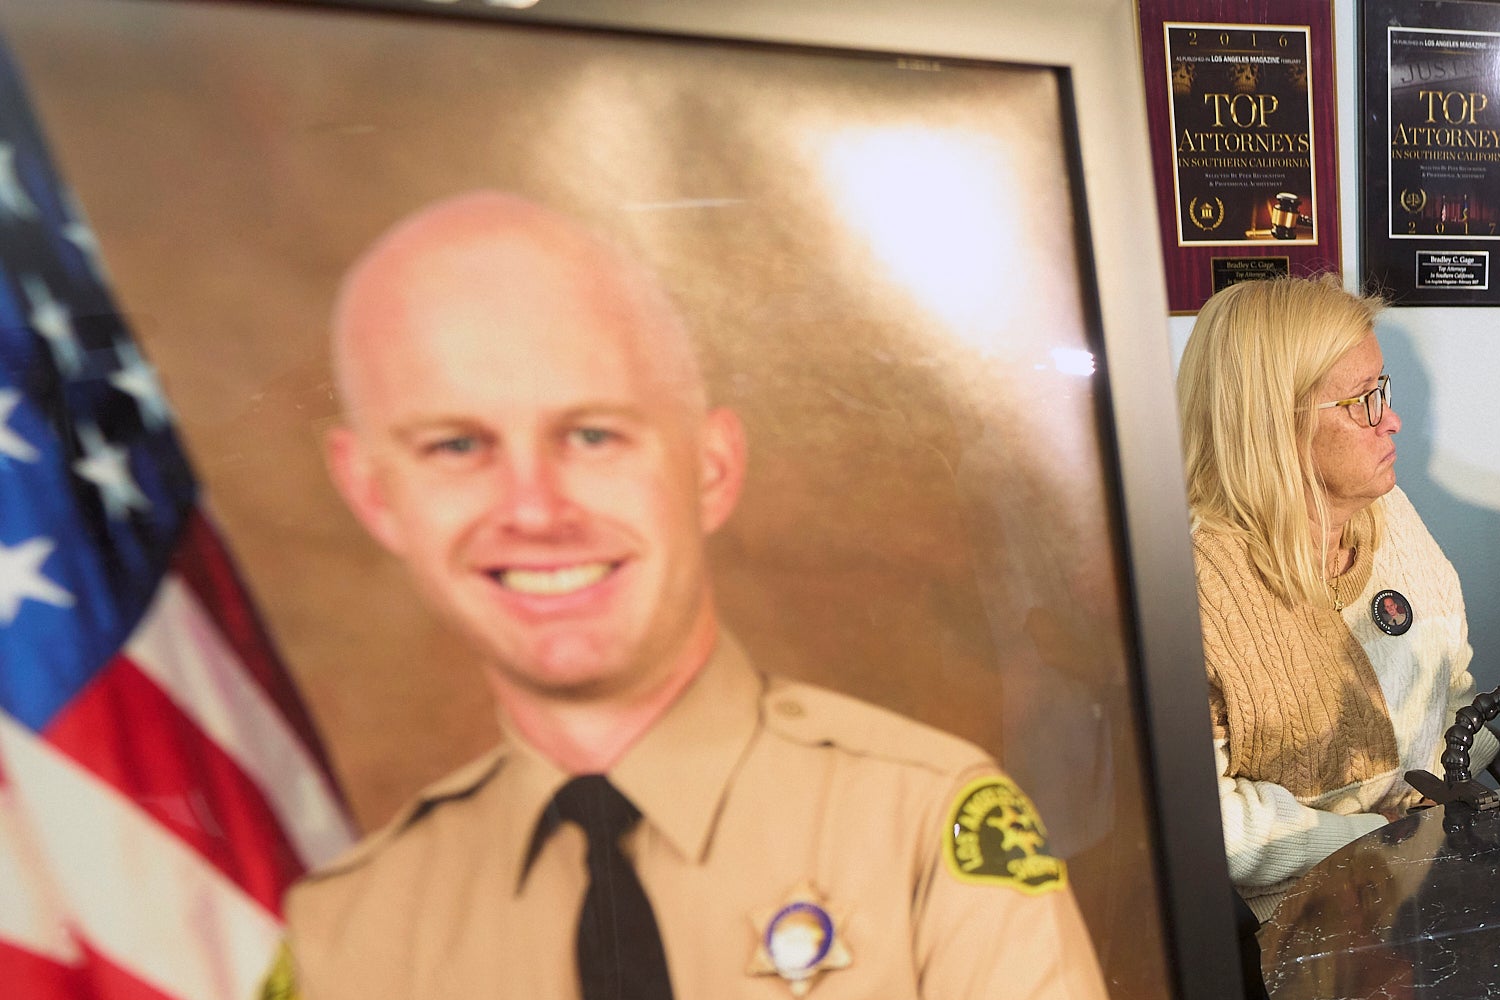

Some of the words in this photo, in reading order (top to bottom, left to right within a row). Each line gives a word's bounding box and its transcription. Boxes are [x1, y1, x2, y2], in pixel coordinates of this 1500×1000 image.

[1211, 55, 1222, 63] LOS
[1204, 93, 1279, 128] TOP
[1419, 91, 1488, 125] TOP
[1178, 128, 1309, 153] ATTORNEYS
[1392, 150, 1402, 159] IN
[1403, 150, 1456, 160] SOUTHERN
[1178, 157, 1189, 167] IN
[1191, 157, 1248, 168] SOUTHERN
[1249, 157, 1309, 168] CALIFORNIA
[1430, 255, 1451, 265] Bradley
[1460, 256, 1475, 266] Gage
